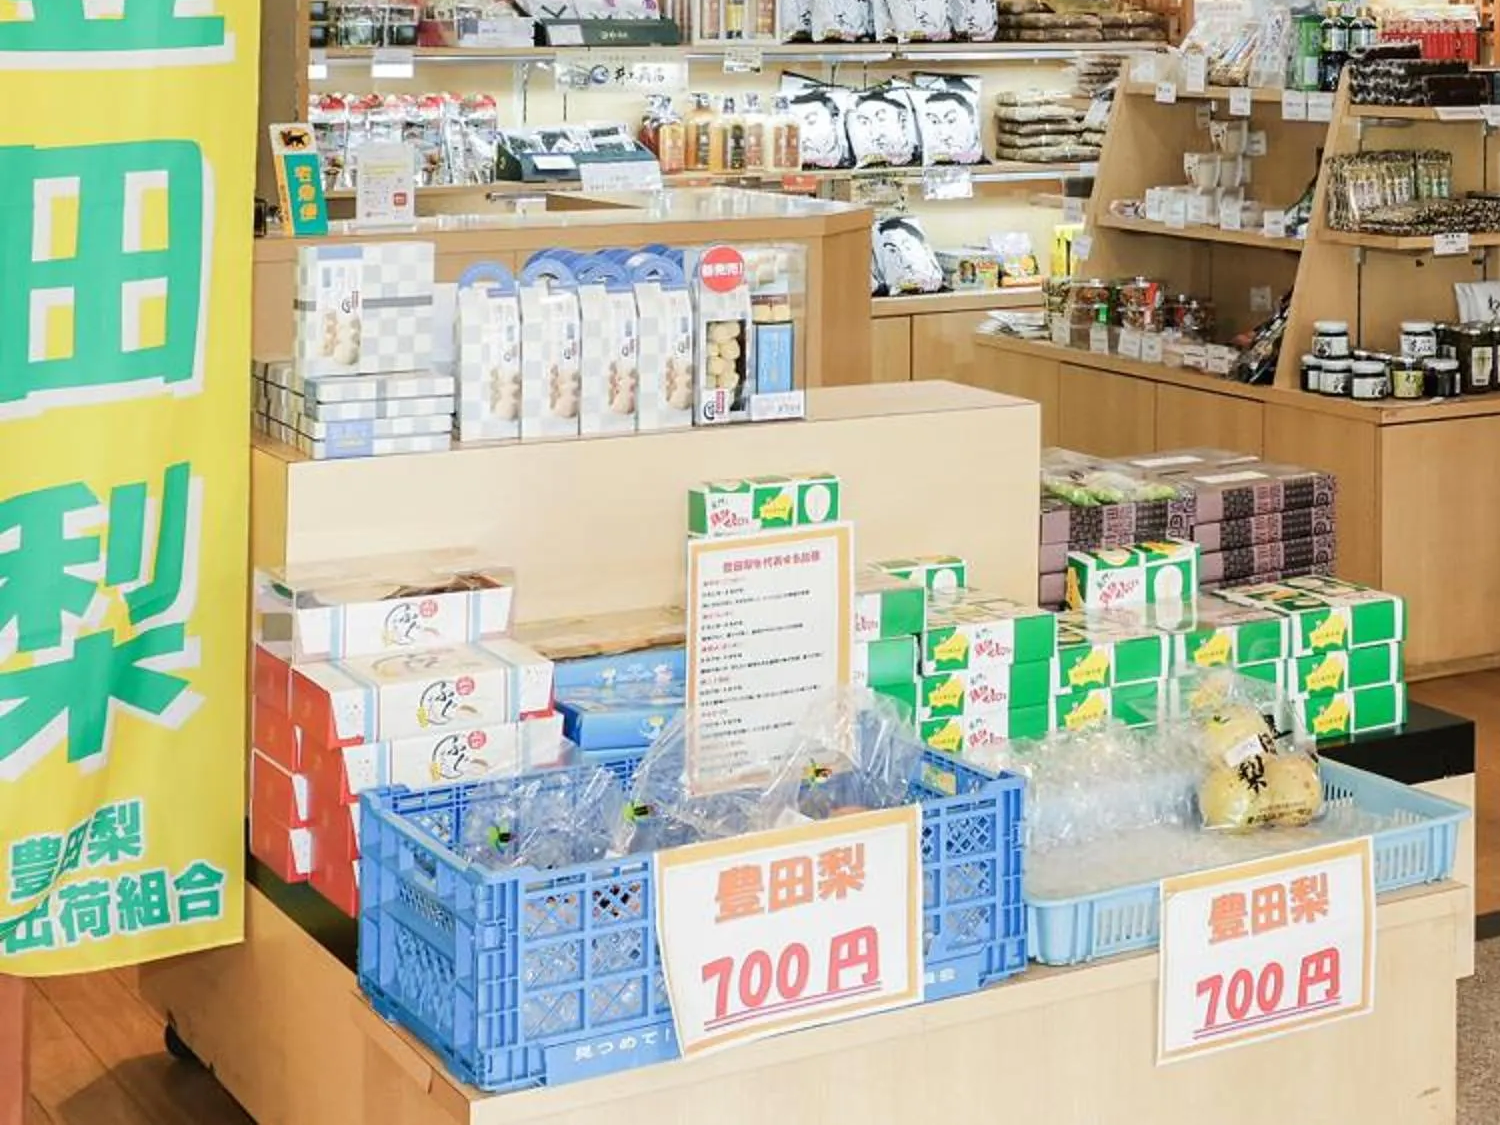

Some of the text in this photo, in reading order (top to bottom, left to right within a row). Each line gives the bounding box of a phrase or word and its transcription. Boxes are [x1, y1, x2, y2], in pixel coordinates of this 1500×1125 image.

[714, 842, 867, 925] 豊田梨
[1208, 871, 1331, 946] 豊田梨
[701, 925, 880, 1021] 700円
[1195, 946, 1342, 1028] 700円
